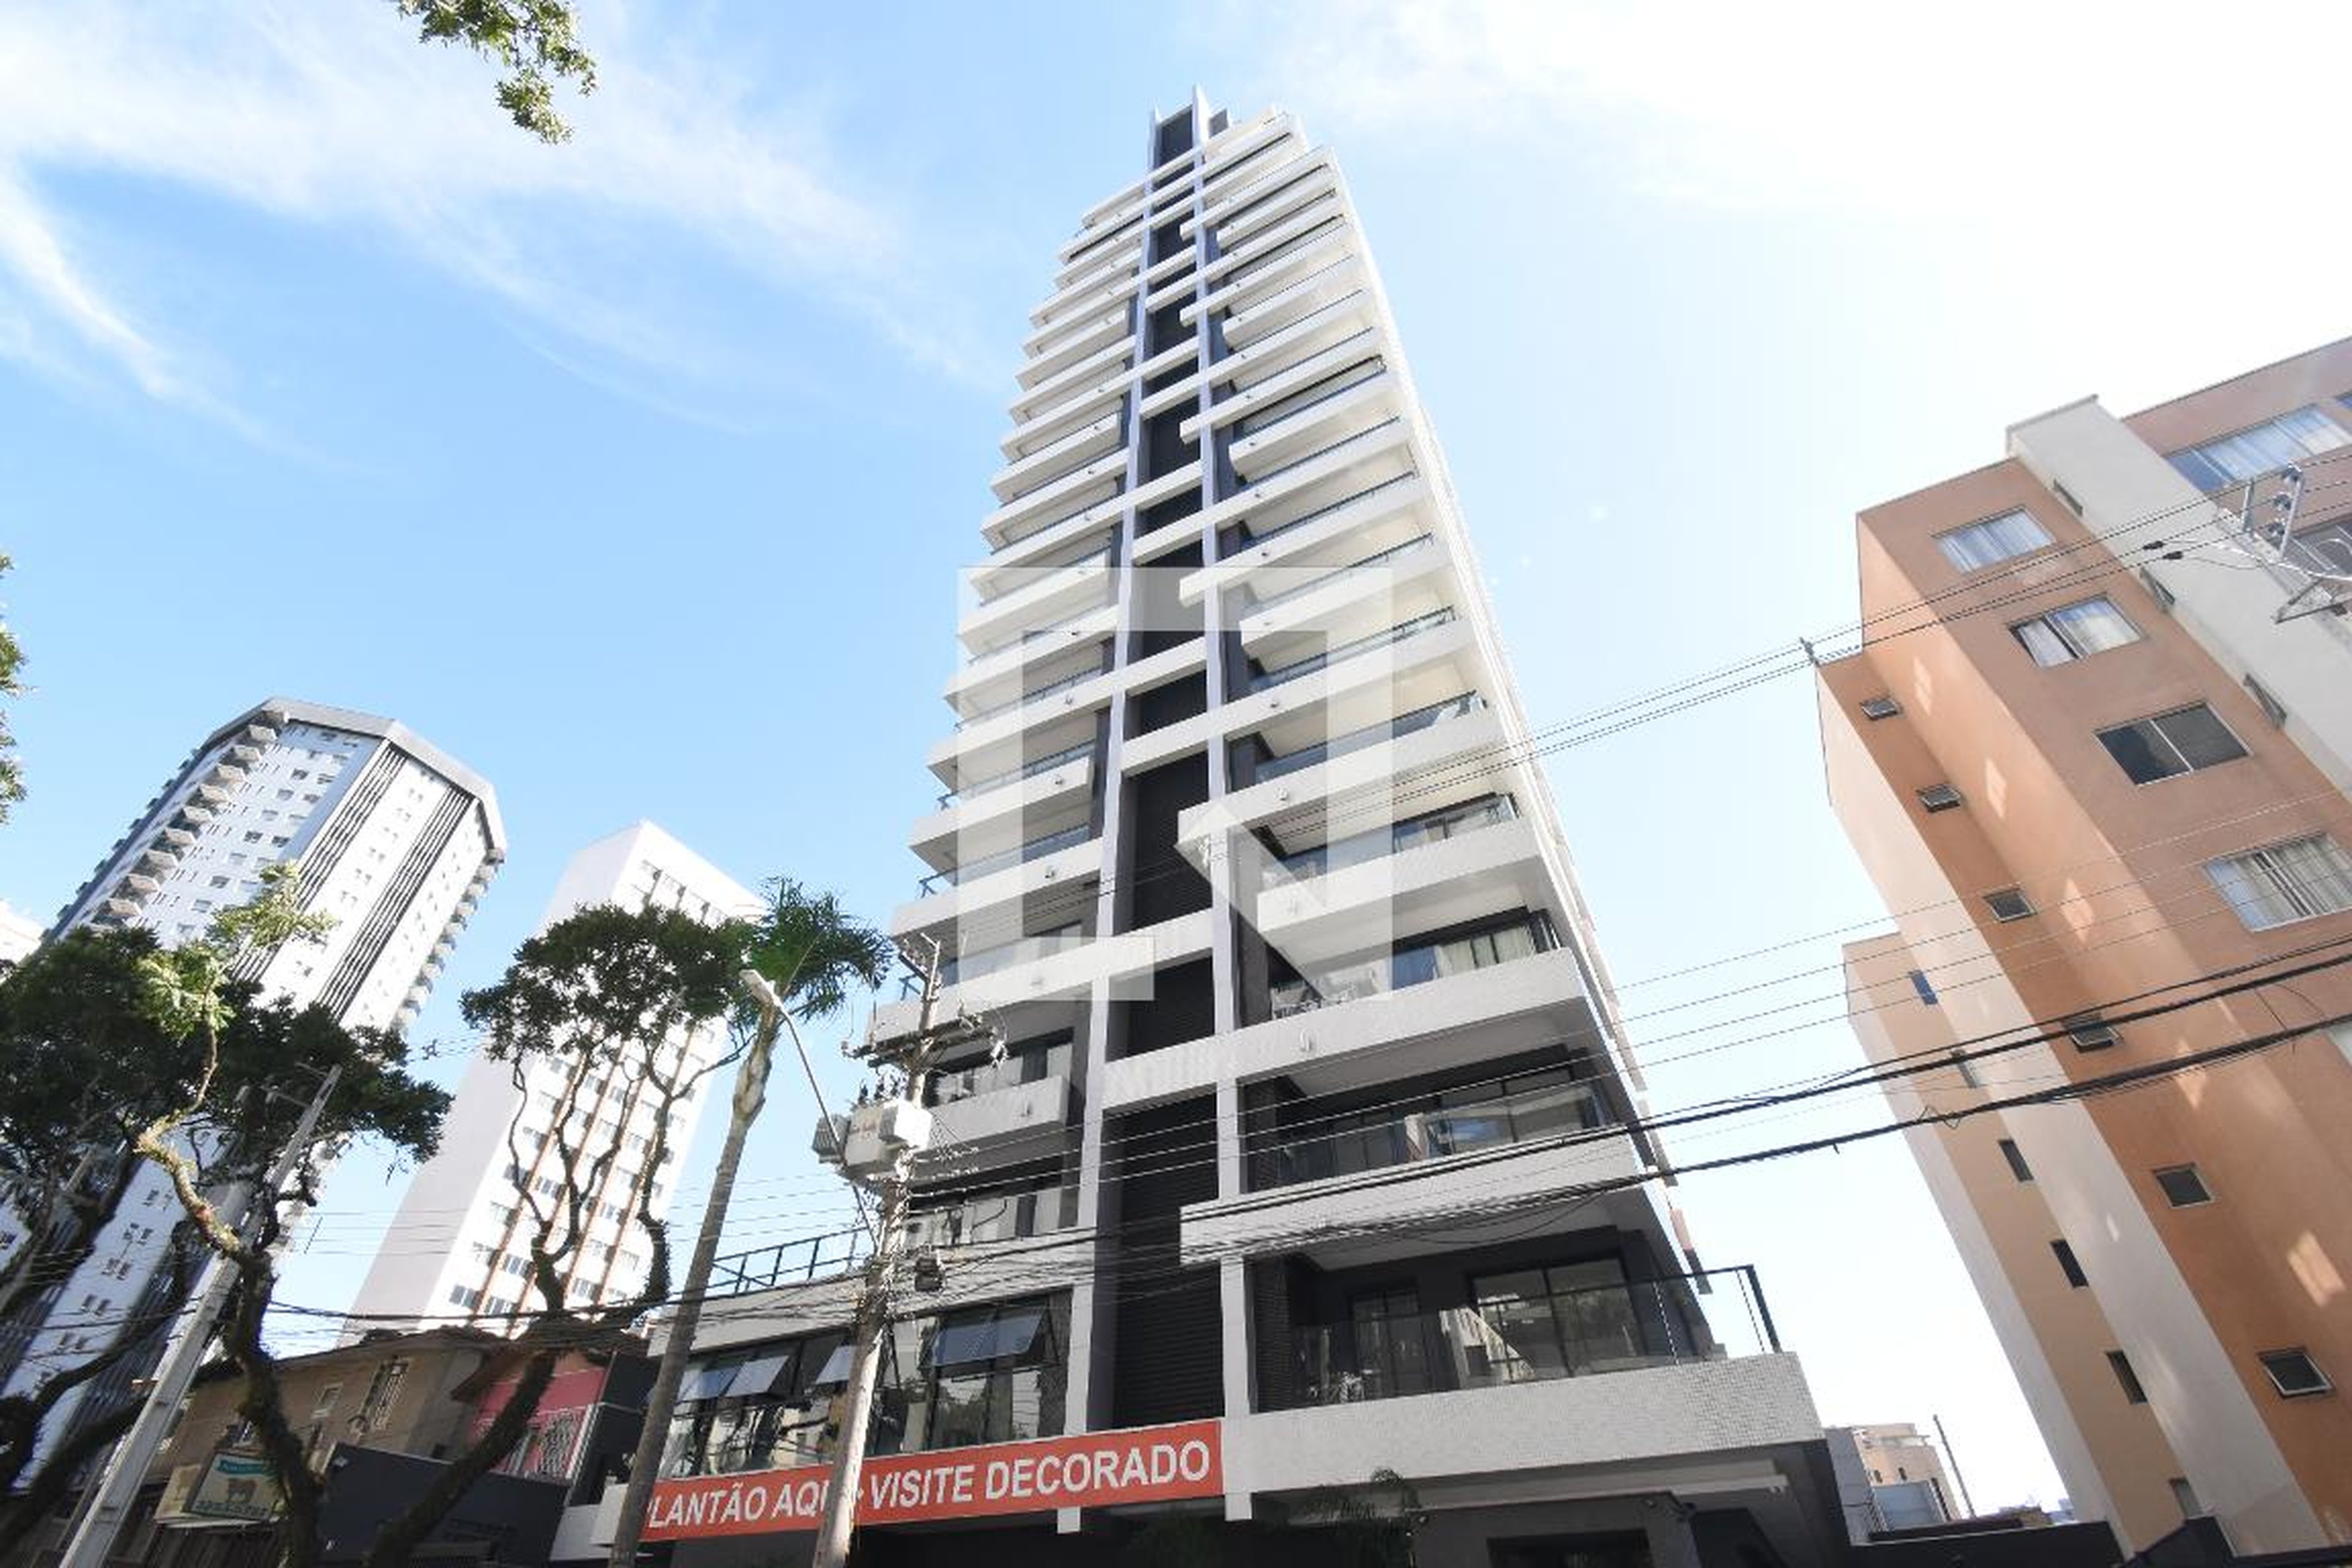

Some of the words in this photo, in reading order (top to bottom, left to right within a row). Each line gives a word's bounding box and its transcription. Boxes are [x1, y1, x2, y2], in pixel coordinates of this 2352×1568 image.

[647, 1481, 766, 1528] LANTÃO
[870, 1464, 975, 1509] VISITE
[985, 1439, 1210, 1499] DECORADO
